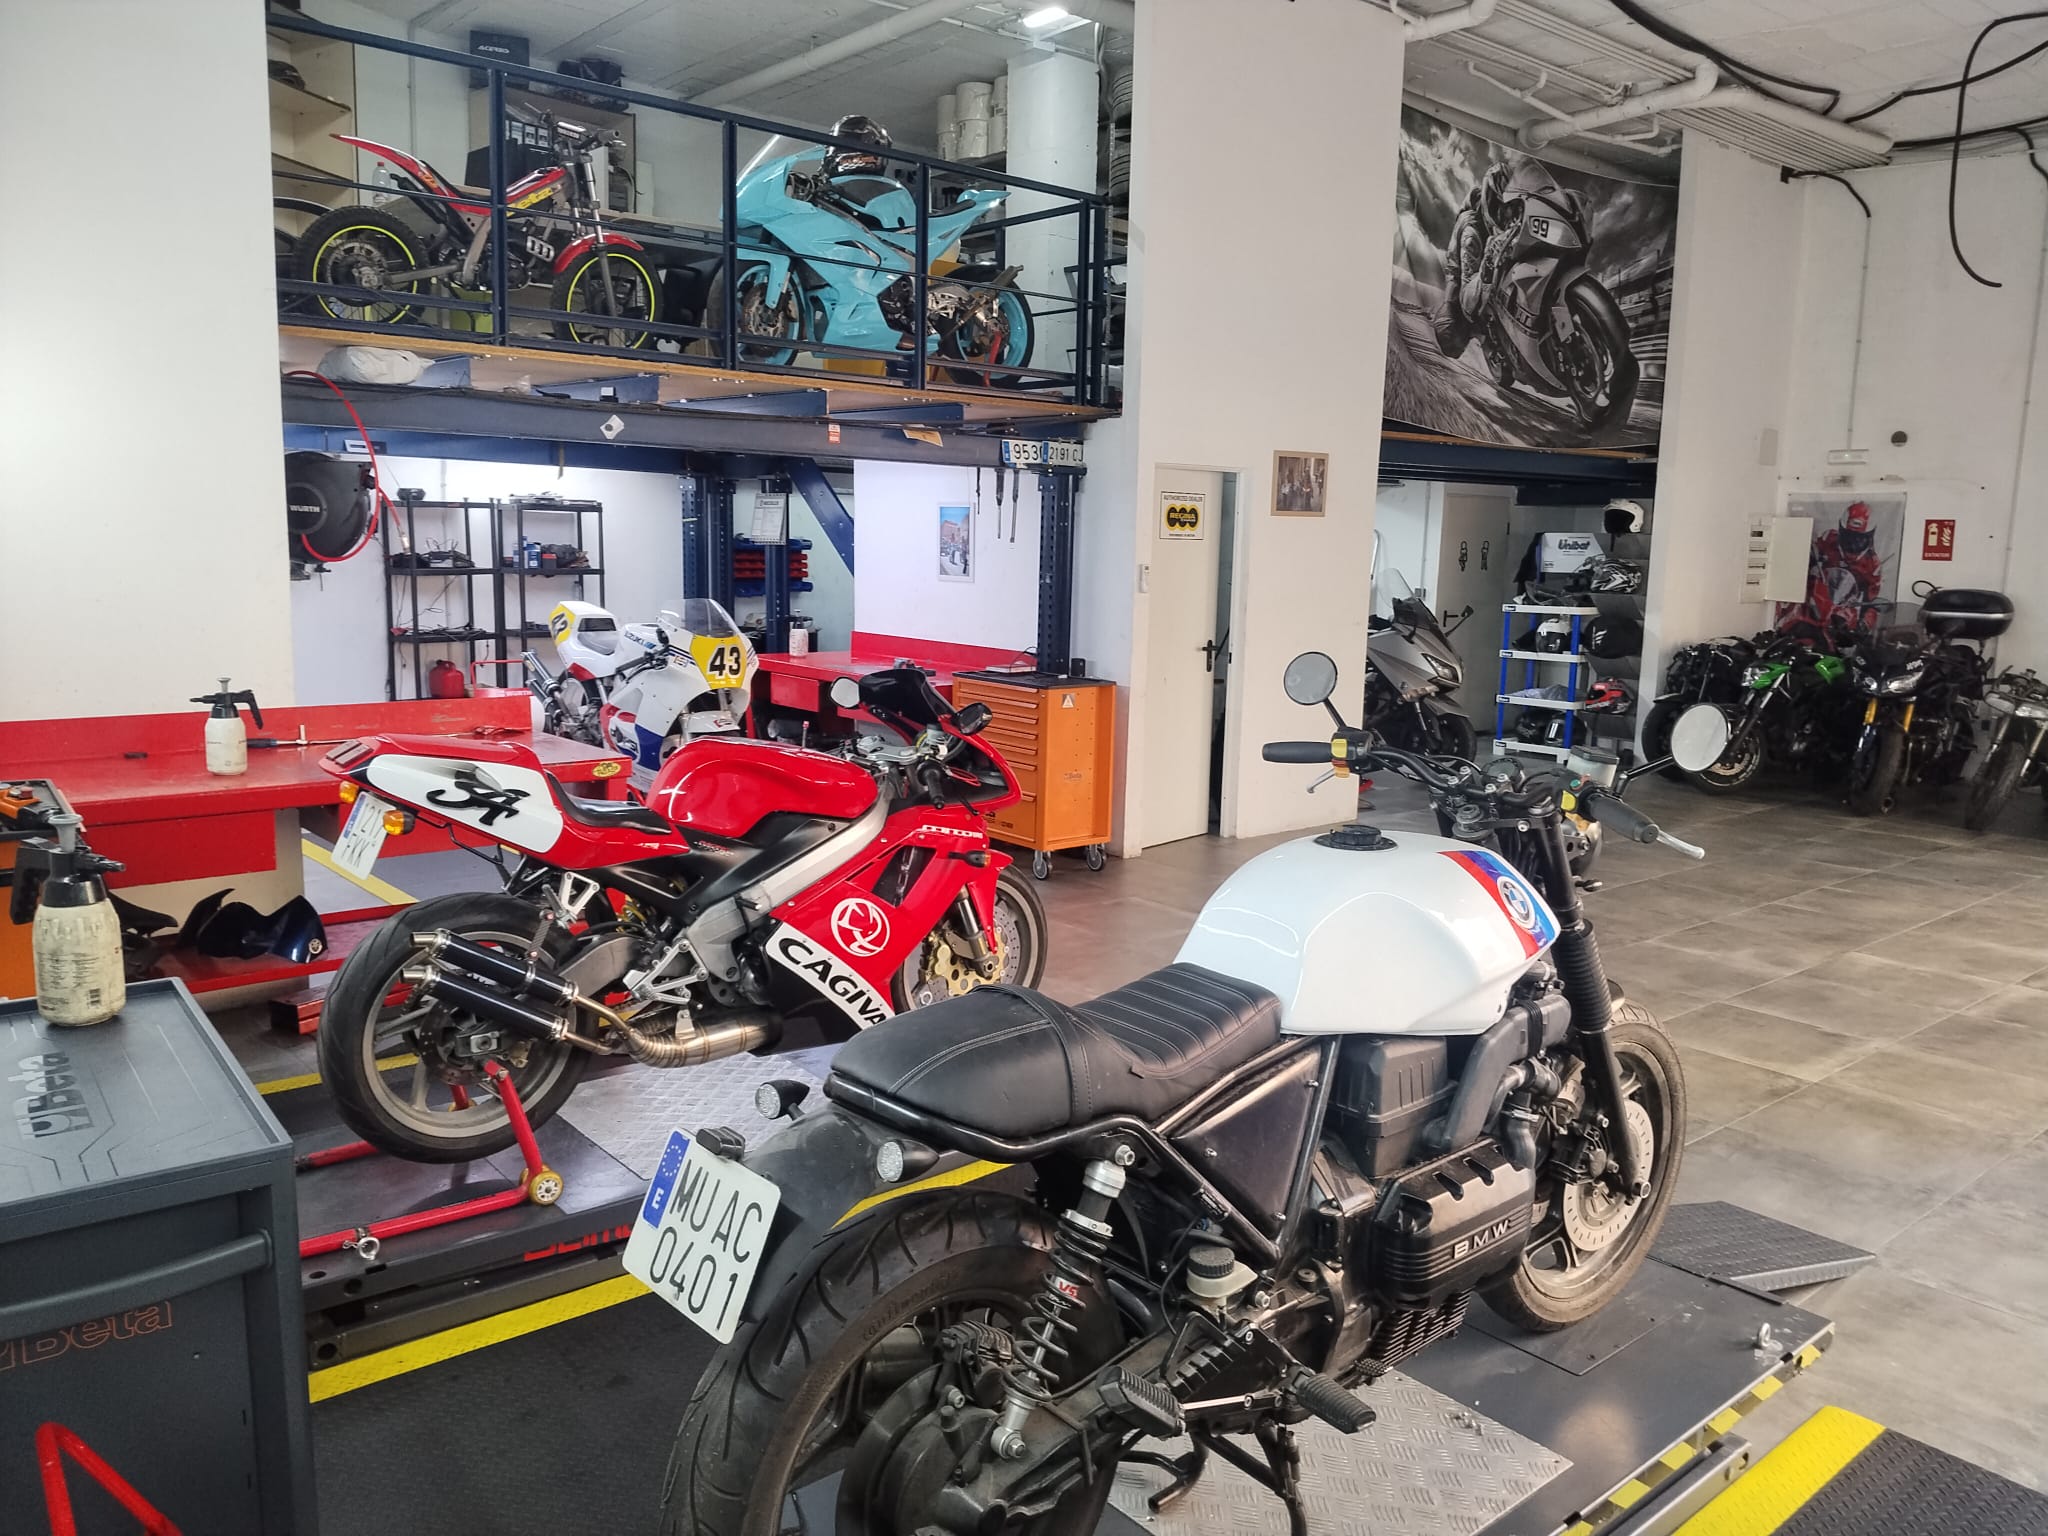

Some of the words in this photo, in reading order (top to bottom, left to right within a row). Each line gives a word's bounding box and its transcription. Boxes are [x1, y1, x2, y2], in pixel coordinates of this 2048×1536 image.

[1533, 218, 1550, 239] 99
[1013, 443, 1043, 461] 953
[709, 646, 741, 677] 43
[669, 1158, 721, 1233] MU
[710, 1190, 763, 1263] AC
[1454, 1219, 1509, 1260] BMW
[650, 1226, 739, 1331] 0401
